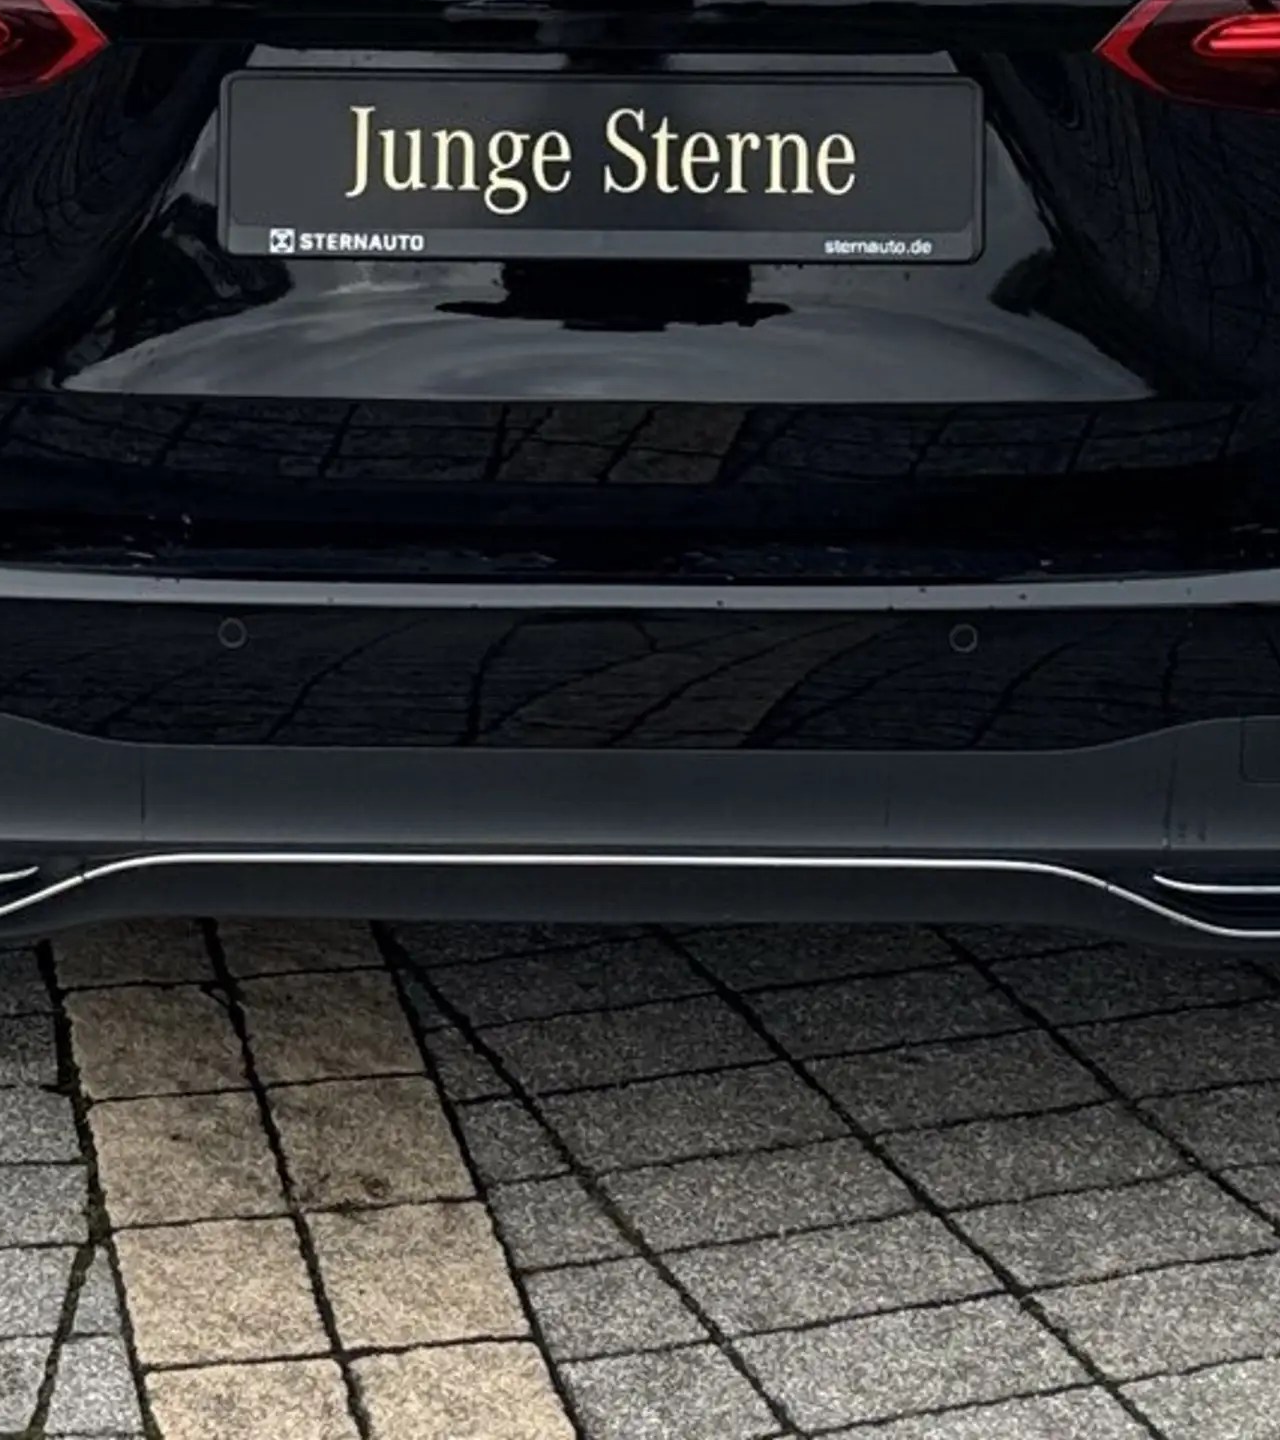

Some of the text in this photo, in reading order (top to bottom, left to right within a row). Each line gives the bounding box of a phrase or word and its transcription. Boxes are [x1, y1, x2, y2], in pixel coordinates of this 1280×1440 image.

[345, 105, 857, 215] Junge Sterne
[299, 232, 425, 252] STERNAUTO
[824, 238, 933, 255] sternauto.de
